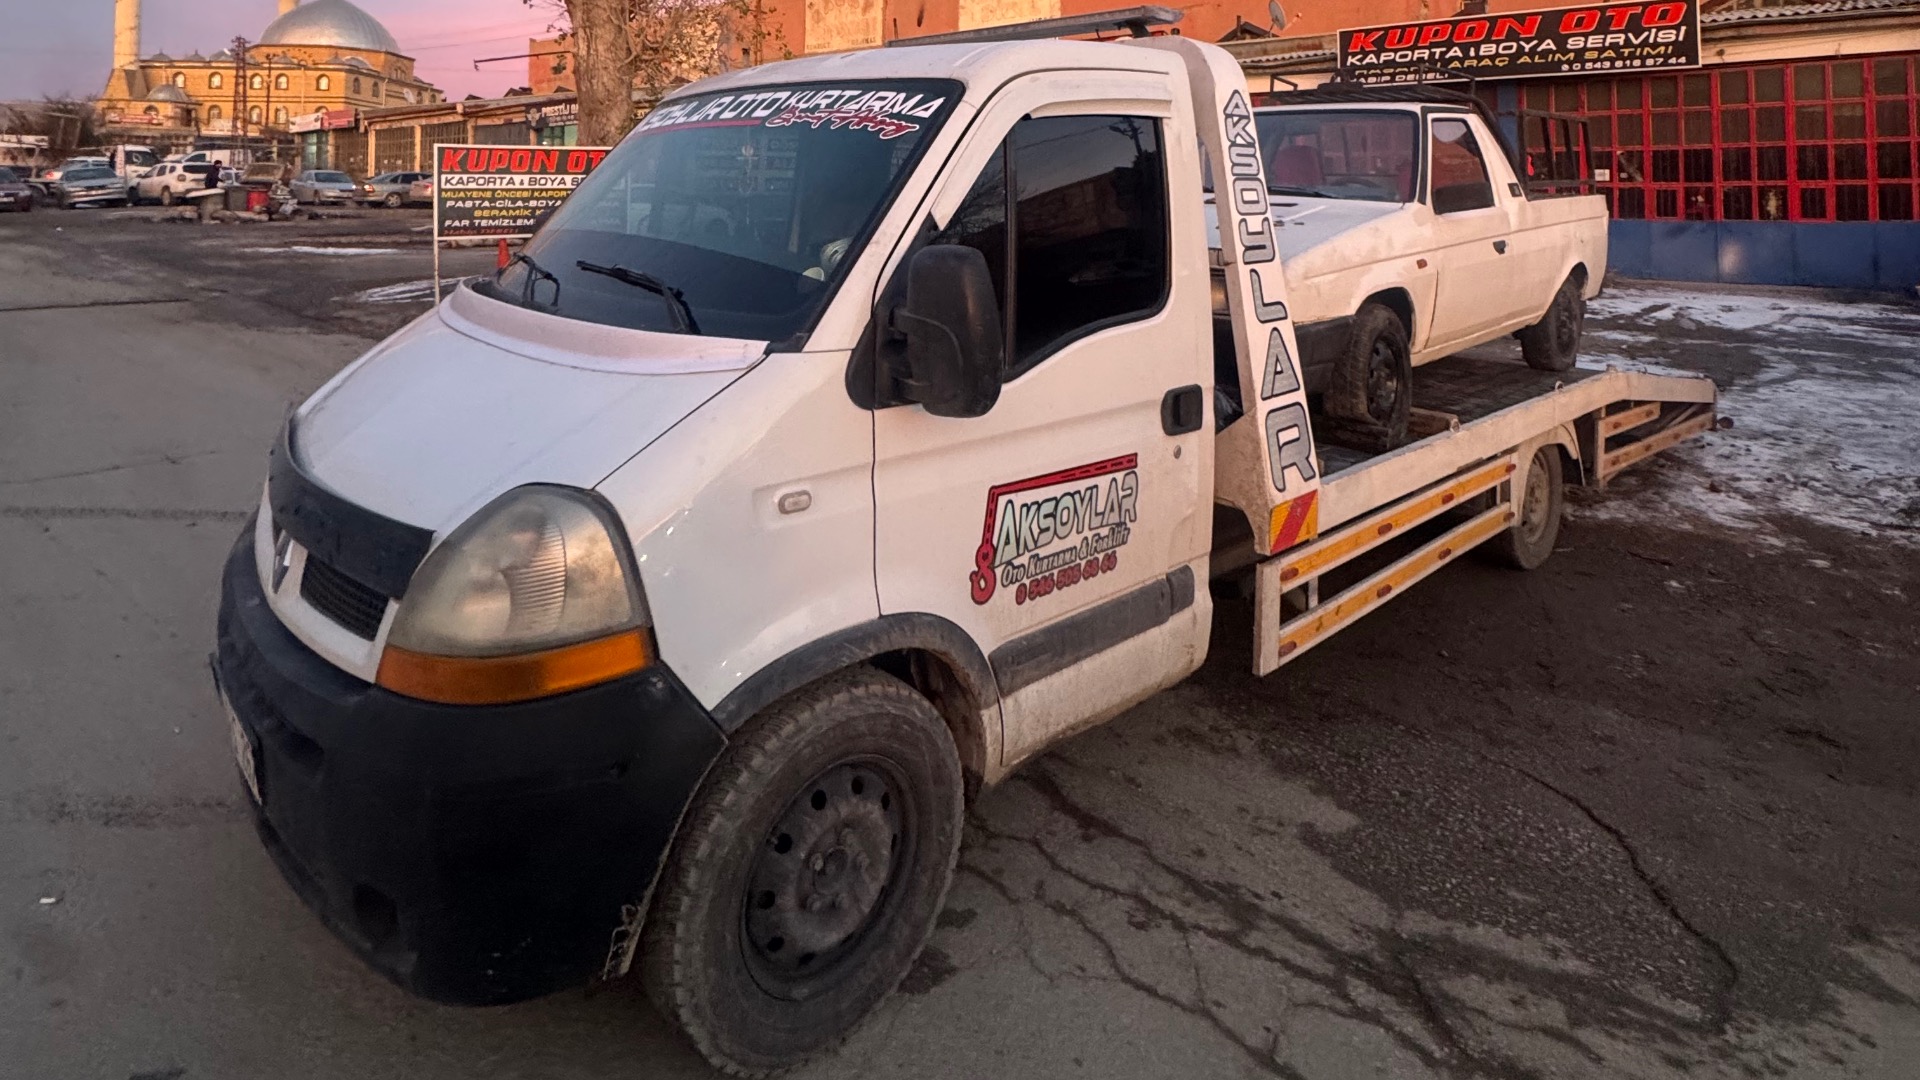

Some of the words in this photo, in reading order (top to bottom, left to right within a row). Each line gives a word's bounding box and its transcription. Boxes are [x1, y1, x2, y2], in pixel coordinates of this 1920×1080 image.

[1348, 15, 1541, 52] KUPON
[1559, 2, 1687, 34] OTO
[1346, 46, 1463, 67] KAPORTA
[1481, 39, 1557, 56] BOYA
[1566, 26, 1686, 49] SERVİSİ
[1448, 57, 1509, 69] ARAÇ
[1517, 52, 1575, 64] ALIM
[1584, 45, 1672, 59] SATIMI
[1585, 61, 1610, 69] 543
[1668, 56, 1686, 64] 44
[719, 91, 791, 119] OTO
[783, 90, 946, 118] KURTARMA
[441, 149, 559, 173] KUPON
[567, 151, 606, 173] OT
[441, 190, 492, 198] MUAYENE
[495, 189, 531, 198] ÖNCESİ
[444, 176, 516, 187] KAPORTA
[528, 176, 567, 187] BOYA
[474, 208, 531, 217] SERAMİK
[474, 218, 537, 227] TEMİZLEM
[1223, 89, 1315, 492] AKSOYLAR
[994, 470, 1138, 568] AKSOYLAR
[1079, 536, 1089, 561] &
[1015, 583, 1027, 605] 0
[1056, 563, 1081, 590] 505
